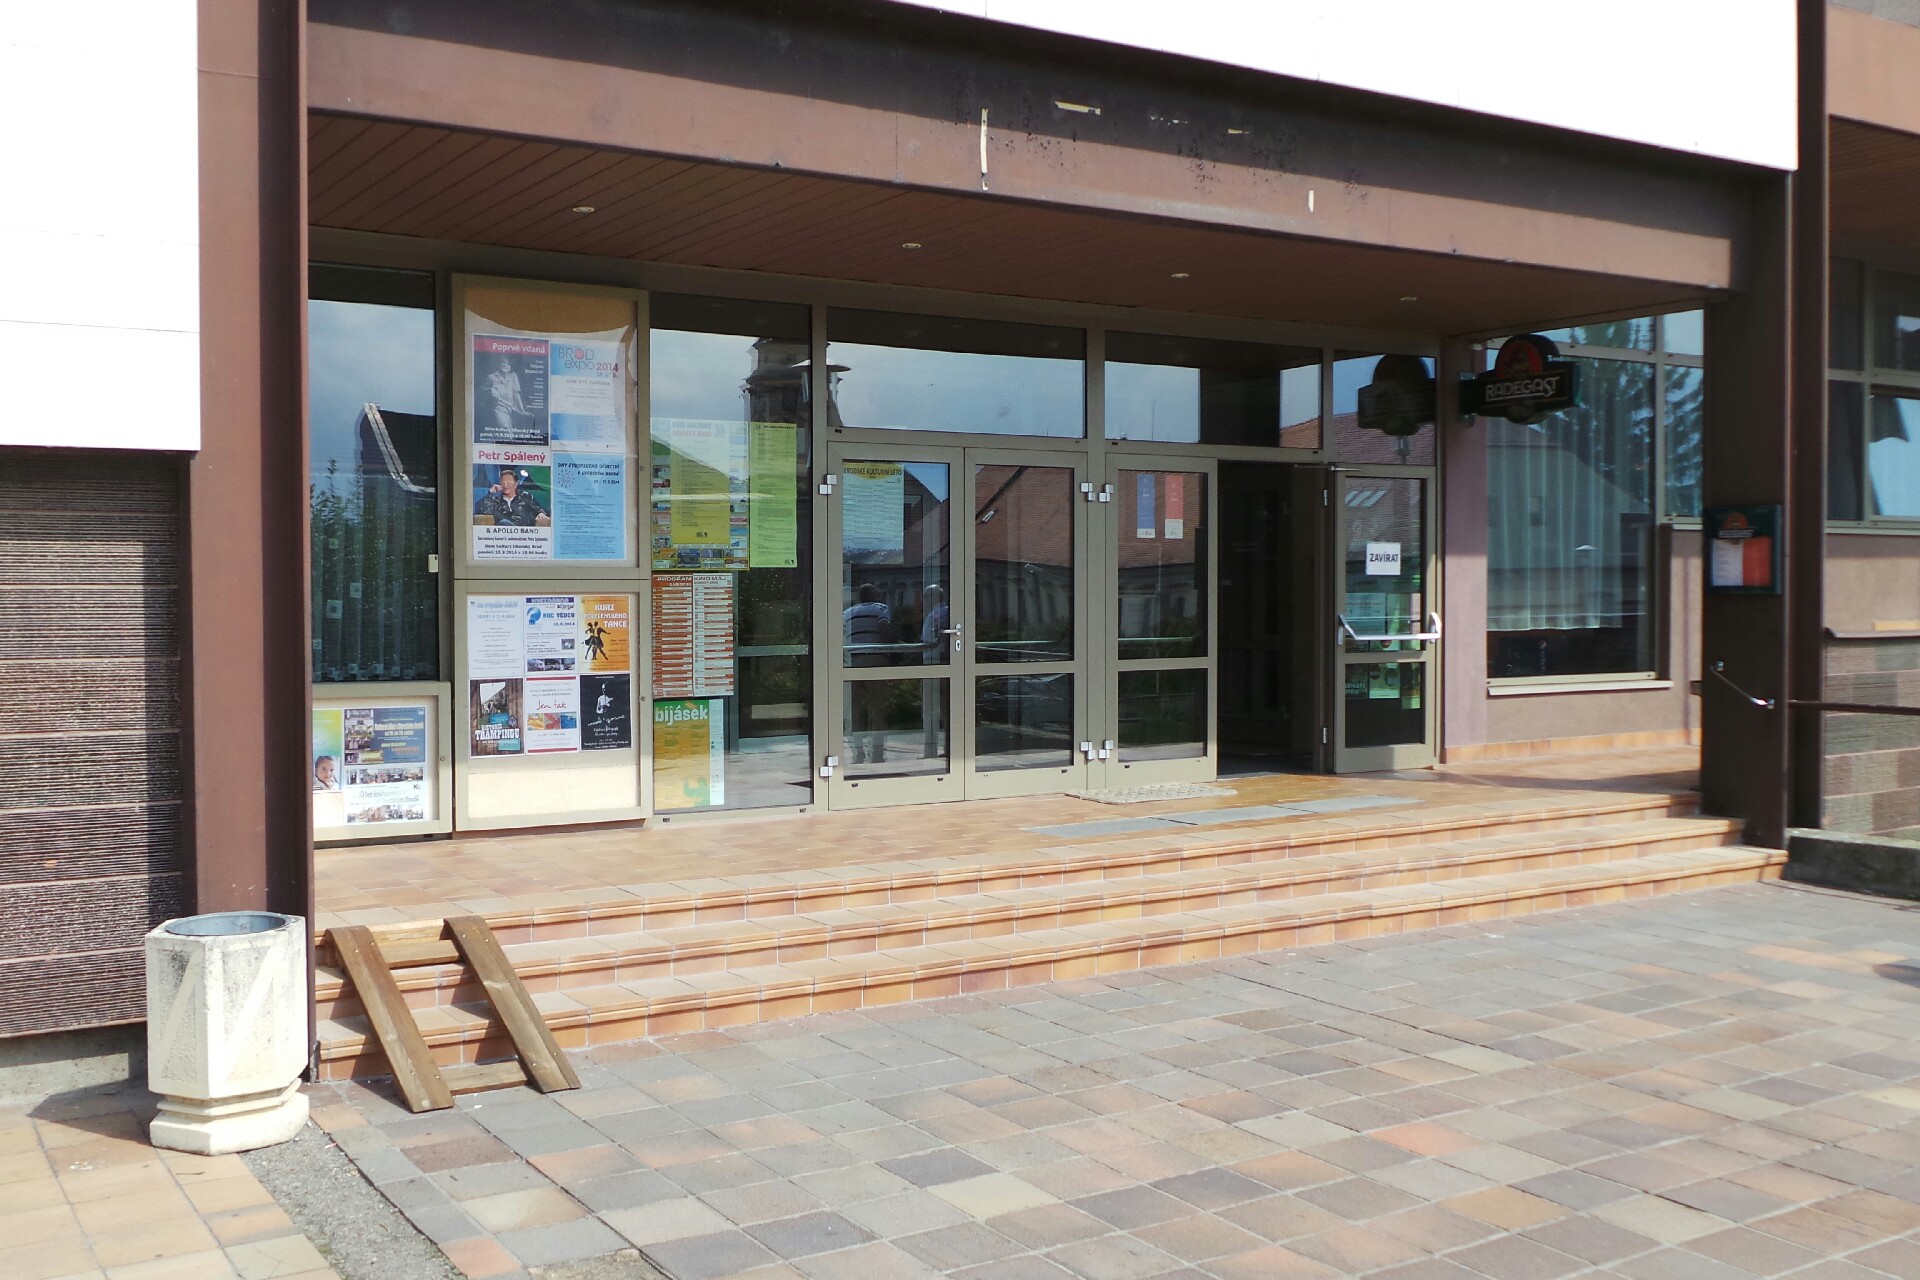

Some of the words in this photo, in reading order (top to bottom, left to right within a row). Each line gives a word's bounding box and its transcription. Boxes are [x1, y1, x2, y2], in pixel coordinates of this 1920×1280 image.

[492, 342, 520, 352] Poprvé
[522, 344, 546, 354] vdaná
[558, 346, 594, 360] BROD
[564, 360, 594, 370] expo
[596, 362, 618, 372] 2014
[1486, 376, 1560, 402] RADEGAST
[478, 450, 501, 460] Petr
[504, 450, 546, 464] Spálený
[1369, 552, 1398, 562] ZAVÍRAT
[536, 700, 551, 710] Jen
[554, 700, 567, 708] tak
[475, 728, 520, 740] TRAMPINGU
